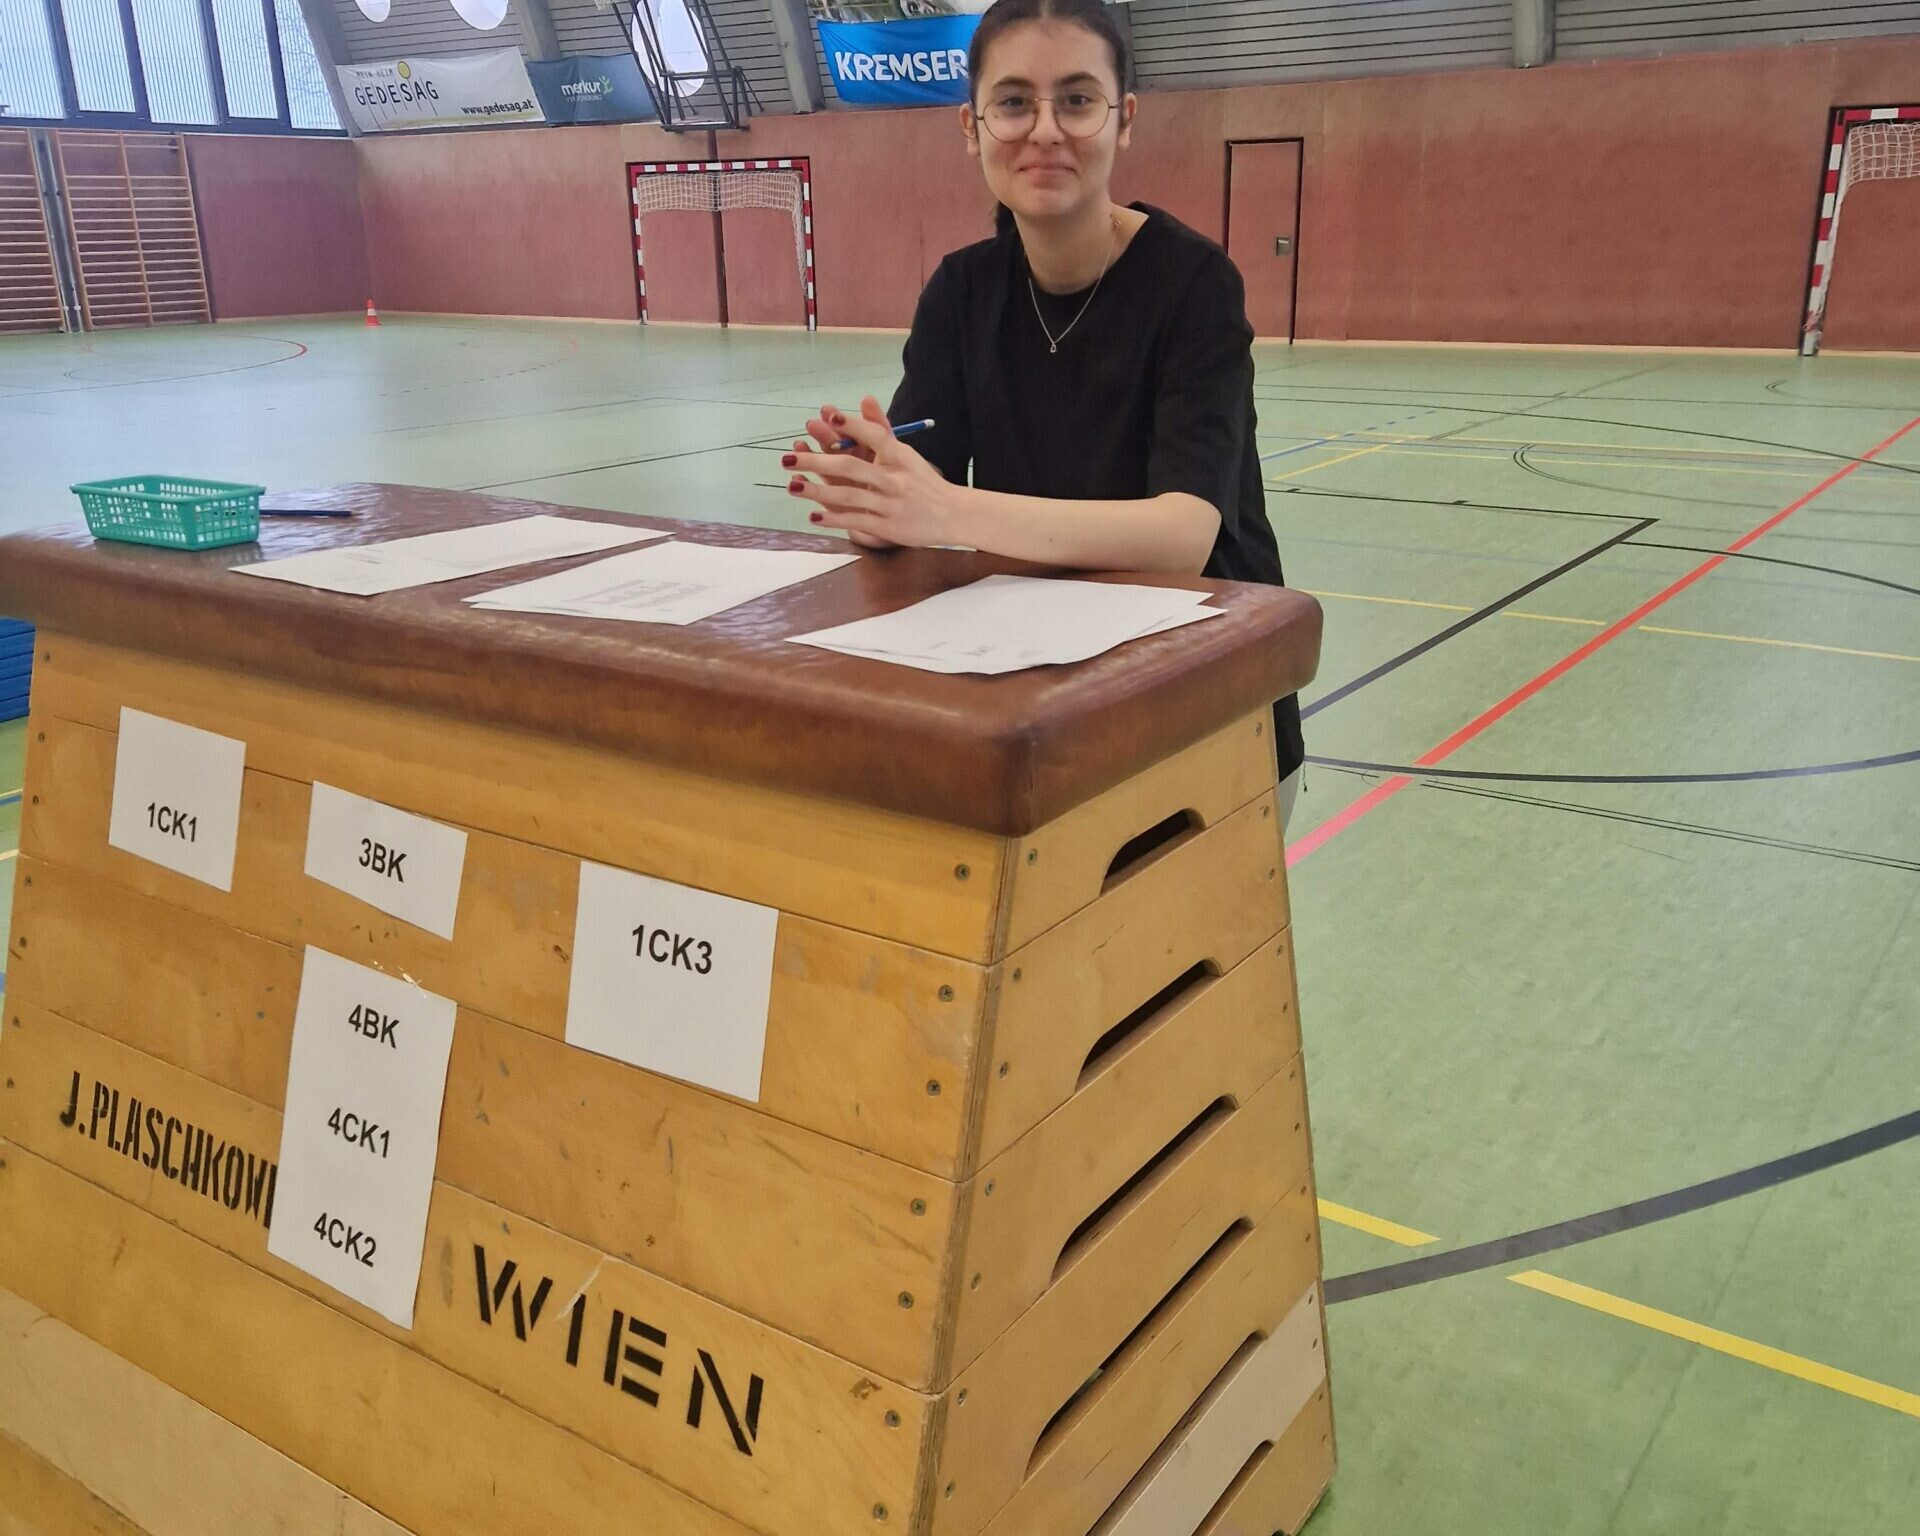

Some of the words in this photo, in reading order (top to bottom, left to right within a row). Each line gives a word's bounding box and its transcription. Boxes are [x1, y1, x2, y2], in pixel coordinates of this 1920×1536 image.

[834, 49, 969, 82] KREMSER
[354, 80, 439, 105] GEDESAG
[461, 100, 535, 116] www.gedesag.at
[561, 80, 601, 96] merkur
[147, 802, 198, 843] 1CK1
[358, 838, 407, 882] 3BK
[632, 924, 713, 975] 1CK3
[348, 1004, 400, 1049] 4BK
[328, 1107, 391, 1158] 4CK1
[313, 1212, 377, 1268] 4CK2
[474, 1244, 764, 1456] WIEN
